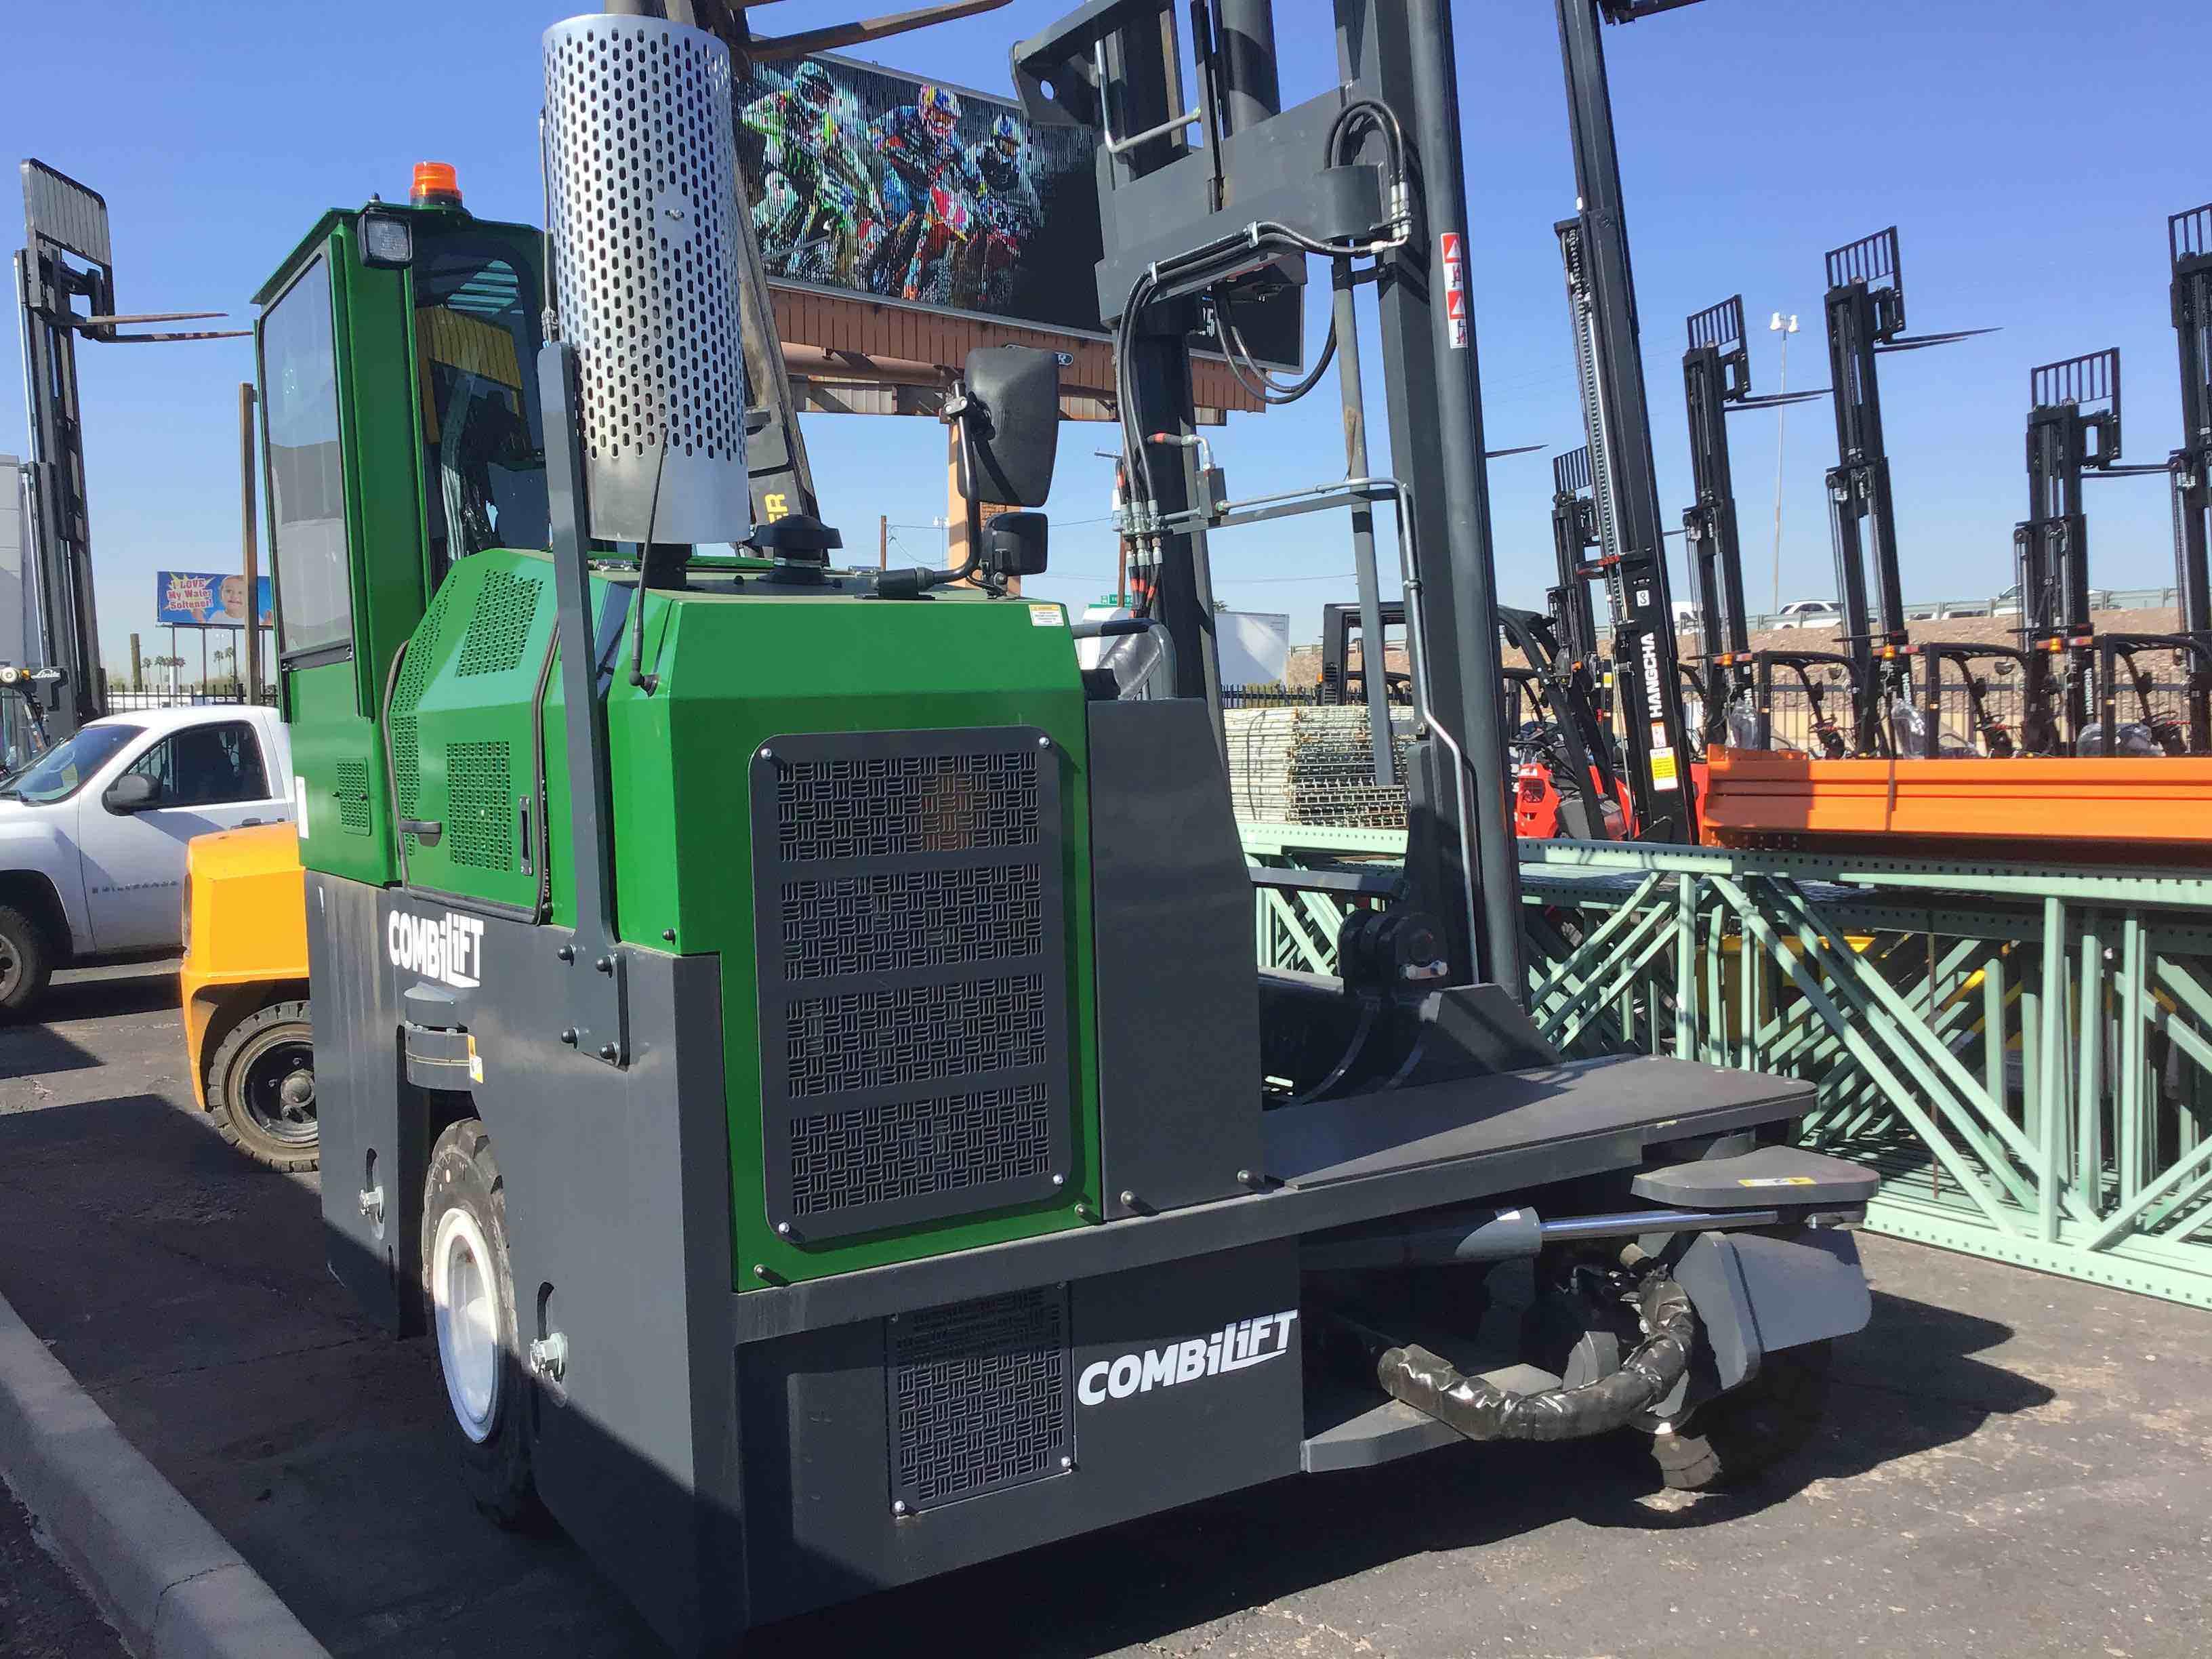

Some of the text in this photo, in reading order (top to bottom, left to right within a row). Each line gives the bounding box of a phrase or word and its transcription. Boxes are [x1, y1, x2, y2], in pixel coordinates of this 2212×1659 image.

[180, 579, 204, 589] LOVE
[168, 589, 212, 600] My Water
[1641, 632, 1662, 718] HANGCHA
